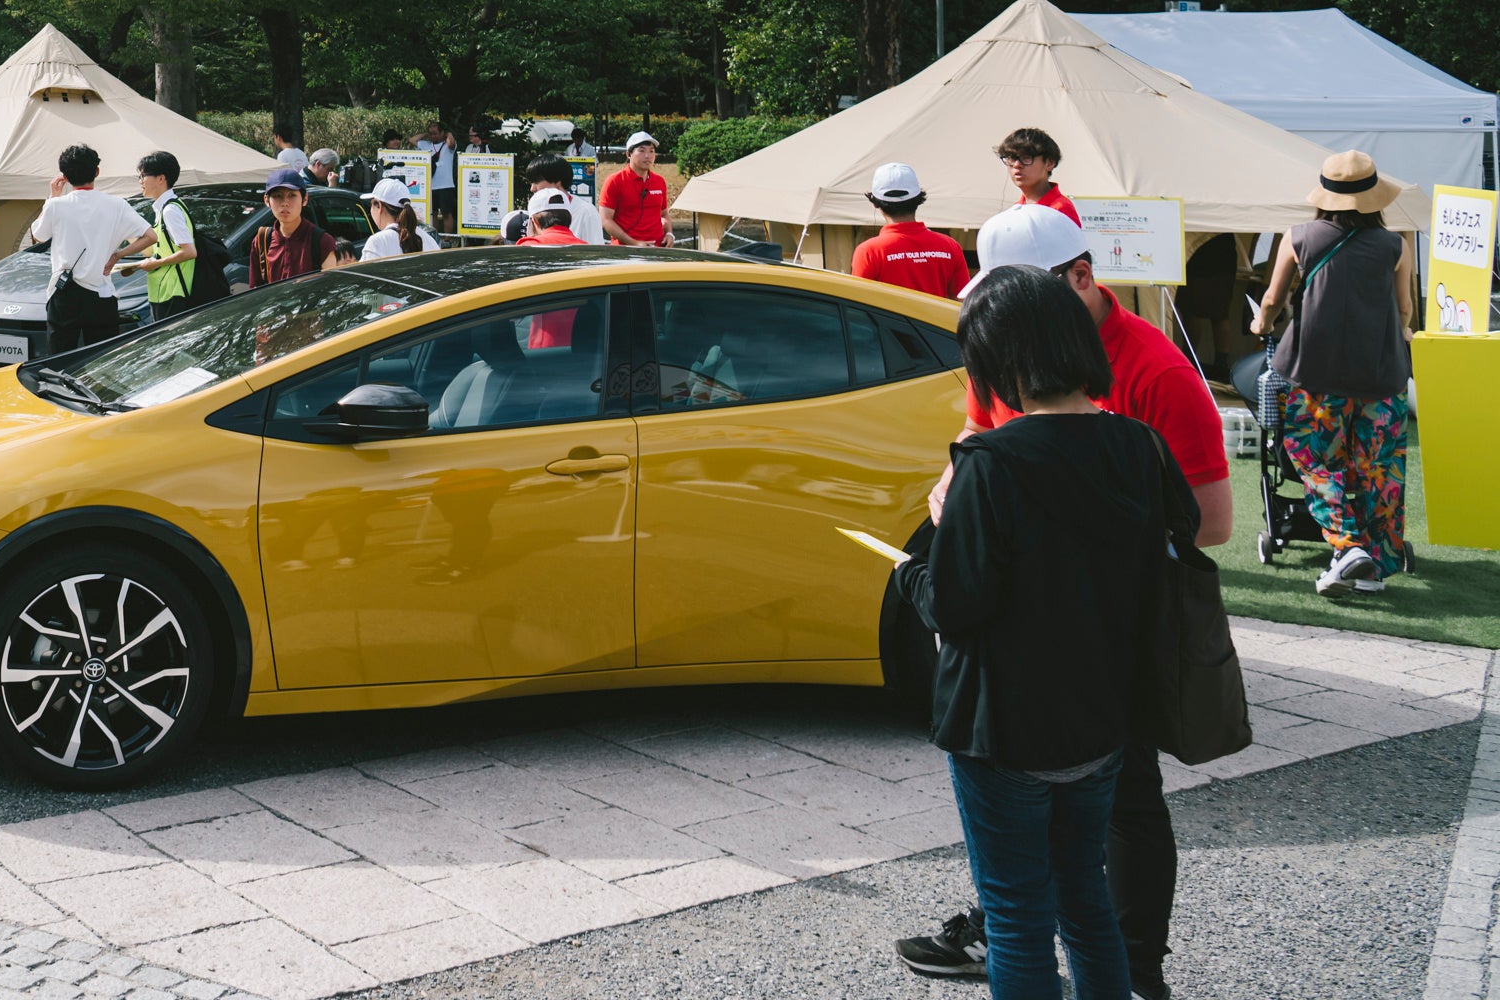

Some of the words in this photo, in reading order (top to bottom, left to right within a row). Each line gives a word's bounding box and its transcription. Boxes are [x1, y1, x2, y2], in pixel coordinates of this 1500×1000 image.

[1443, 208, 1481, 228] もしもフェス
[1438, 232, 1484, 254] スタンプラリー
[886, 252, 905, 262] START
